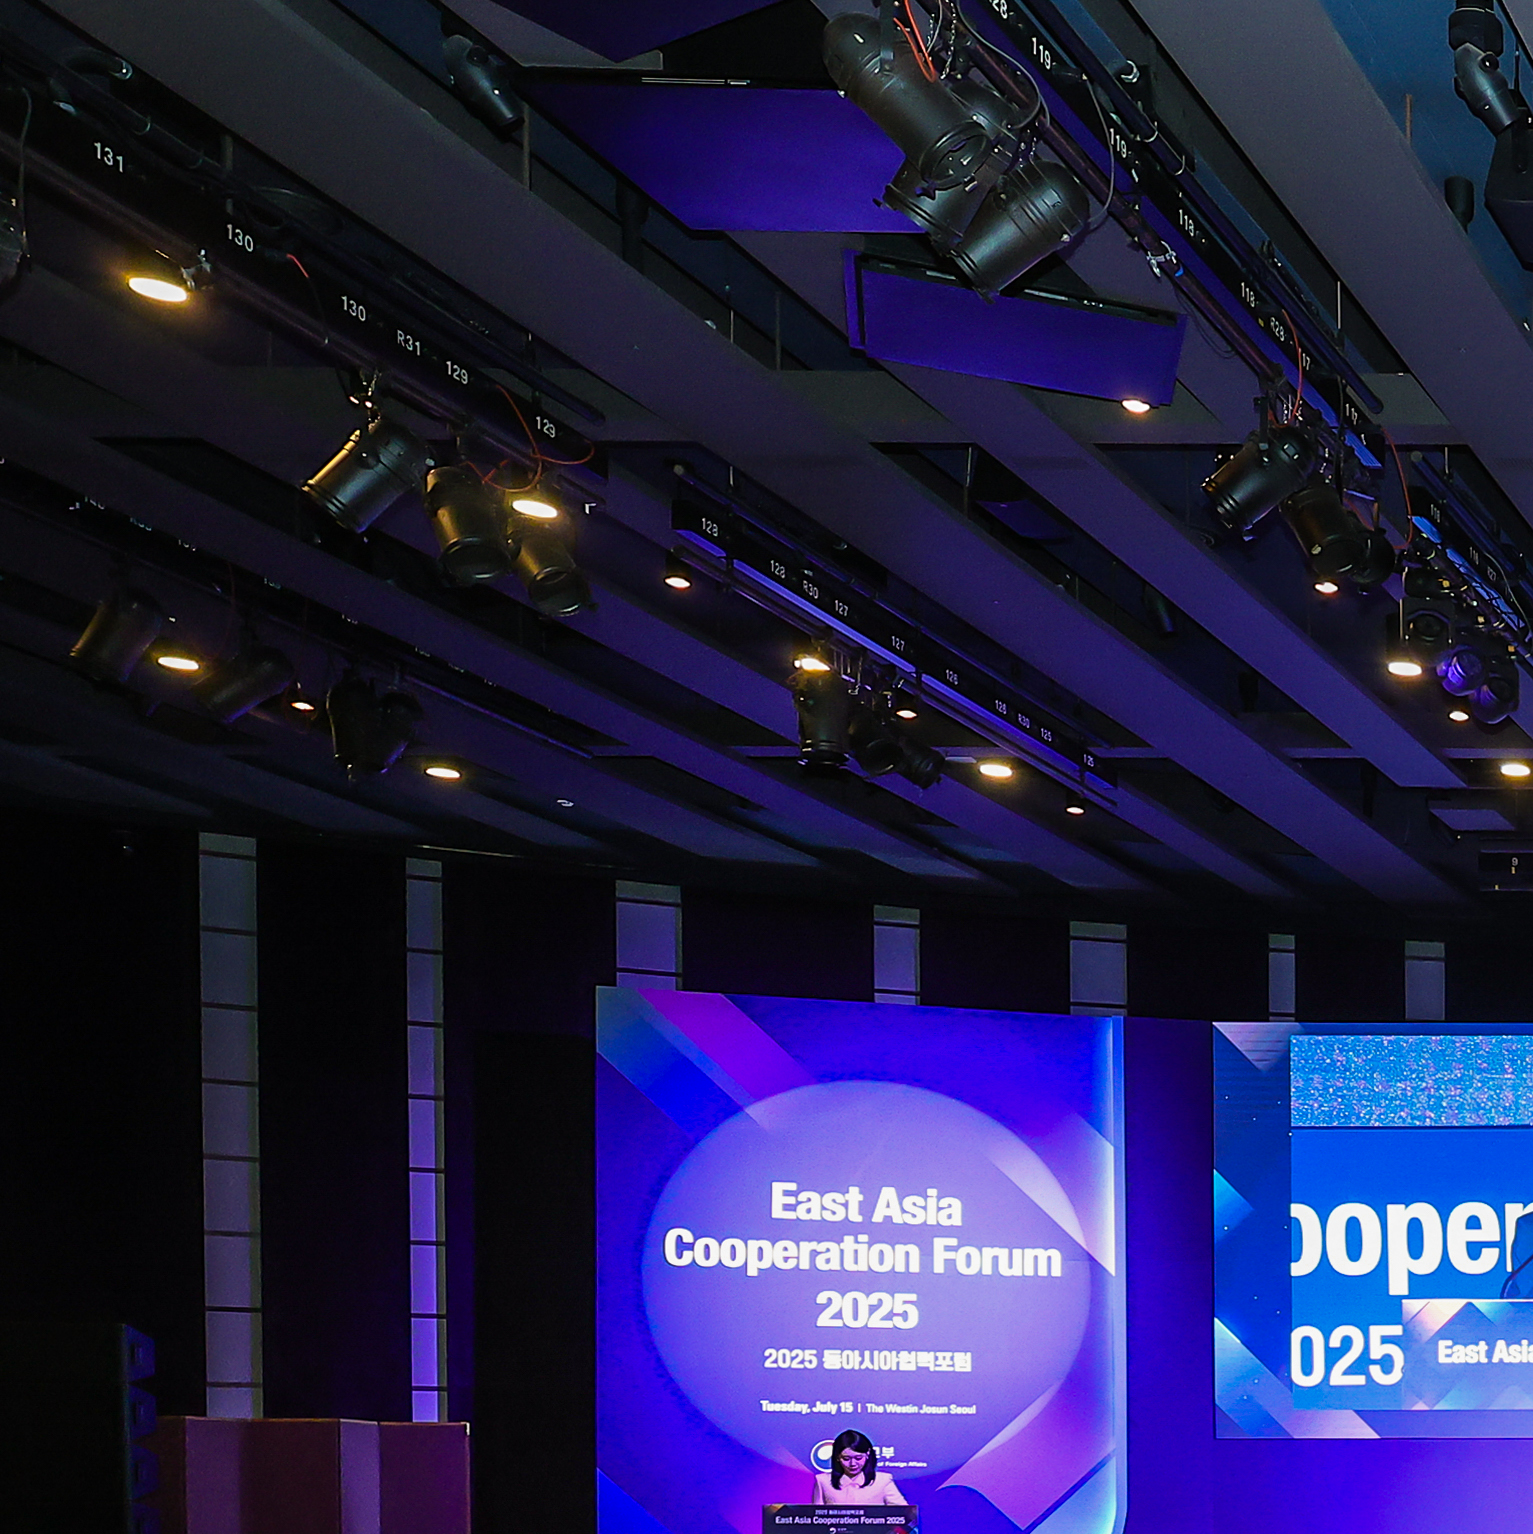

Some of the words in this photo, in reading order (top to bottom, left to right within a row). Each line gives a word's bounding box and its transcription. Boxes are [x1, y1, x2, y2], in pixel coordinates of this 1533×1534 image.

[1031, 36, 1052, 71] 119
[93, 140, 125, 173] 131
[225, 222, 254, 254] 130
[340, 294, 367, 323] 130
[396, 328, 421, 358] R31
[445, 360, 469, 386] 129
[534, 414, 557, 440] 129
[700, 516, 720, 538] 128
[769, 558, 786, 580] 128
[771, 1181, 864, 1222] East
[871, 1186, 962, 1226] Asia
[663, 1227, 920, 1277] Cooperation
[932, 1237, 1062, 1277] Forum
[815, 1290, 919, 1329] 2025
[763, 1348, 818, 1370] 2025
[1437, 1340, 1488, 1364] East
[760, 1400, 810, 1415] Tuesday,
[812, 1401, 838, 1415] July
[839, 1402, 853, 1413] 15
[866, 1403, 884, 1413] The
[885, 1403, 918, 1414] Westin
[920, 1404, 948, 1414] Josun
[949, 1404, 976, 1414] Seoul
[775, 1516, 793, 1524] East
[794, 1516, 811, 1524] Asia
[812, 1516, 859, 1526] Cooperation
[860, 1516, 885, 1525] Forum
[886, 1516, 905, 1524] 2025
